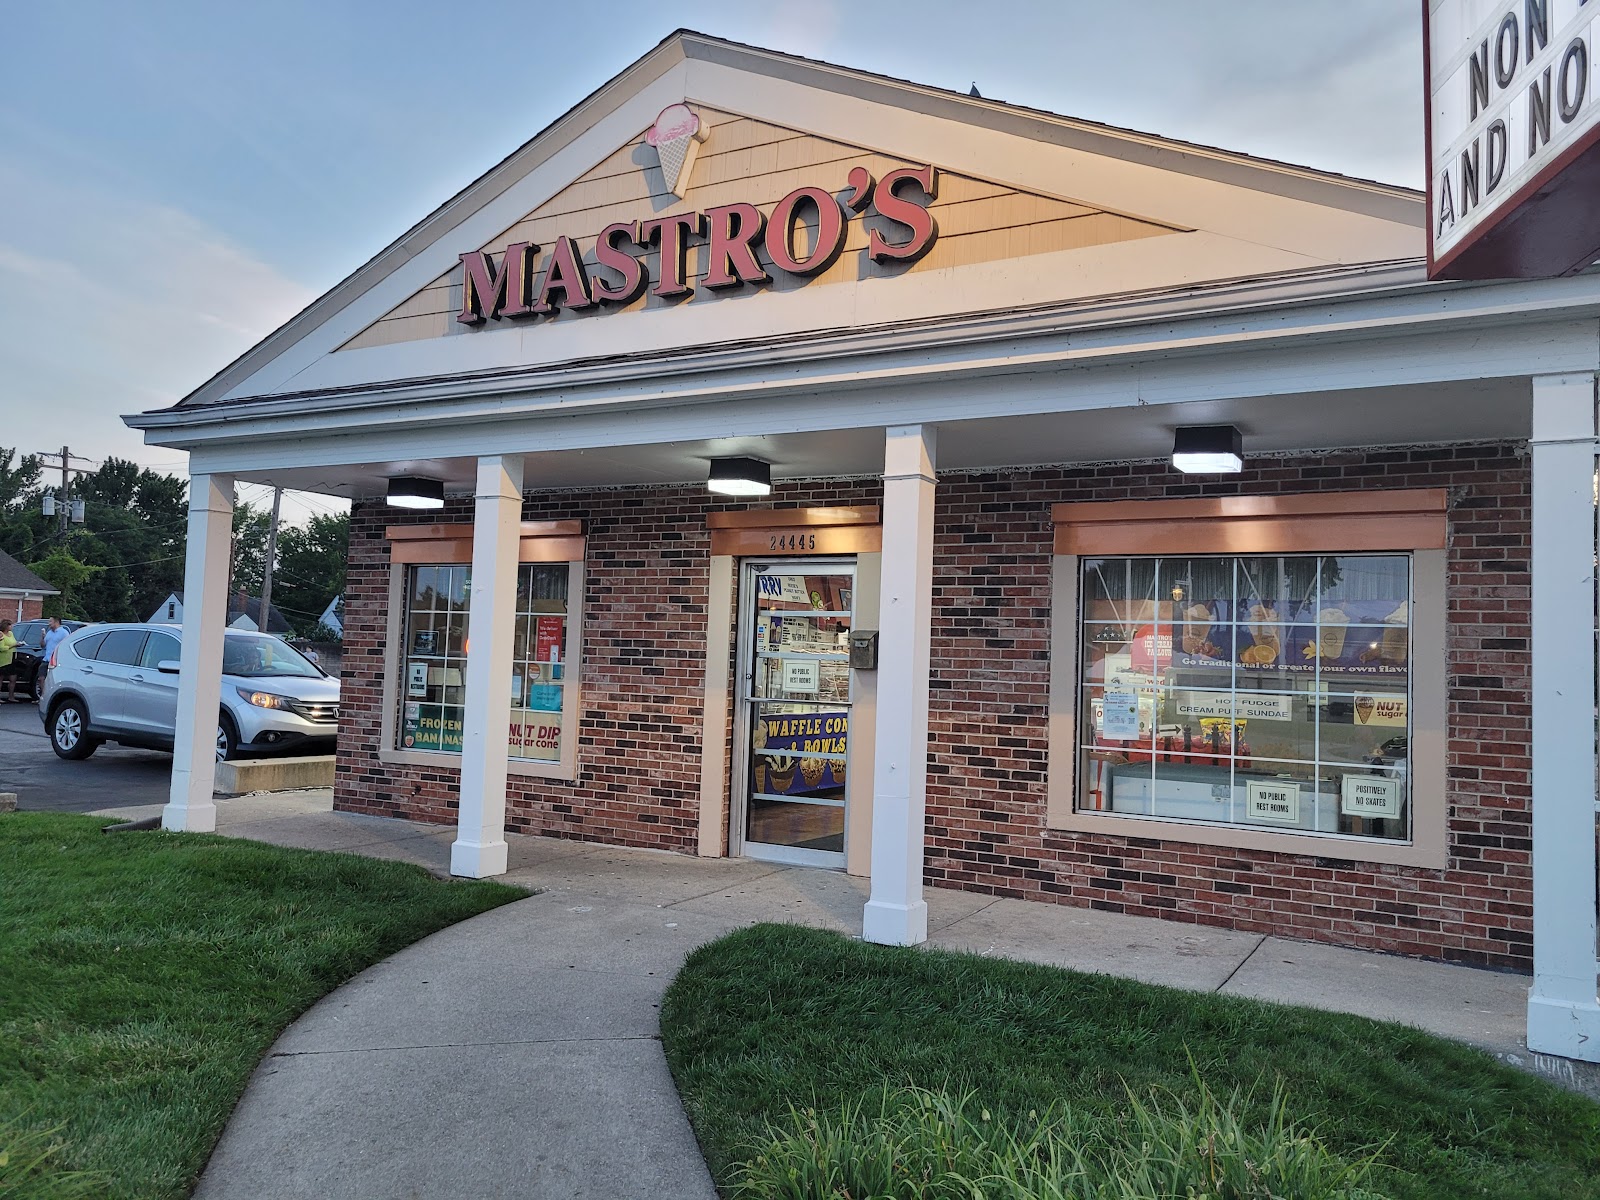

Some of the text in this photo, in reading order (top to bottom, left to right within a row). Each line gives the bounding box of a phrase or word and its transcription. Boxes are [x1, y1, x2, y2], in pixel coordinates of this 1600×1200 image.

[1469, 0, 1548, 123] NON
[1436, 36, 1588, 240] AND NO
[456, 163, 940, 327] MASTRO'S
[769, 534, 815, 551] 24445
[1182, 657, 1196, 666] Go
[1198, 659, 1260, 669] traditonal
[1278, 663, 1315, 671] create
[1348, 665, 1377, 673] own
[1179, 705, 1214, 714] CREAM
[1246, 709, 1289, 718] SUNDAE
[1376, 701, 1404, 712] NUT
[1376, 711, 1404, 719] sugar
[420, 717, 463, 731] FROZEN
[768, 719, 822, 737] WAFFLE
[537, 725, 561, 740] DIP
[535, 739, 559, 749] cone
[1259, 791, 1287, 801] NO PUBLIC
[1355, 784, 1387, 796] POSITIVELY
[1256, 802, 1289, 813] REST ROOMS
[1355, 796, 1387, 807] NO SKATES
